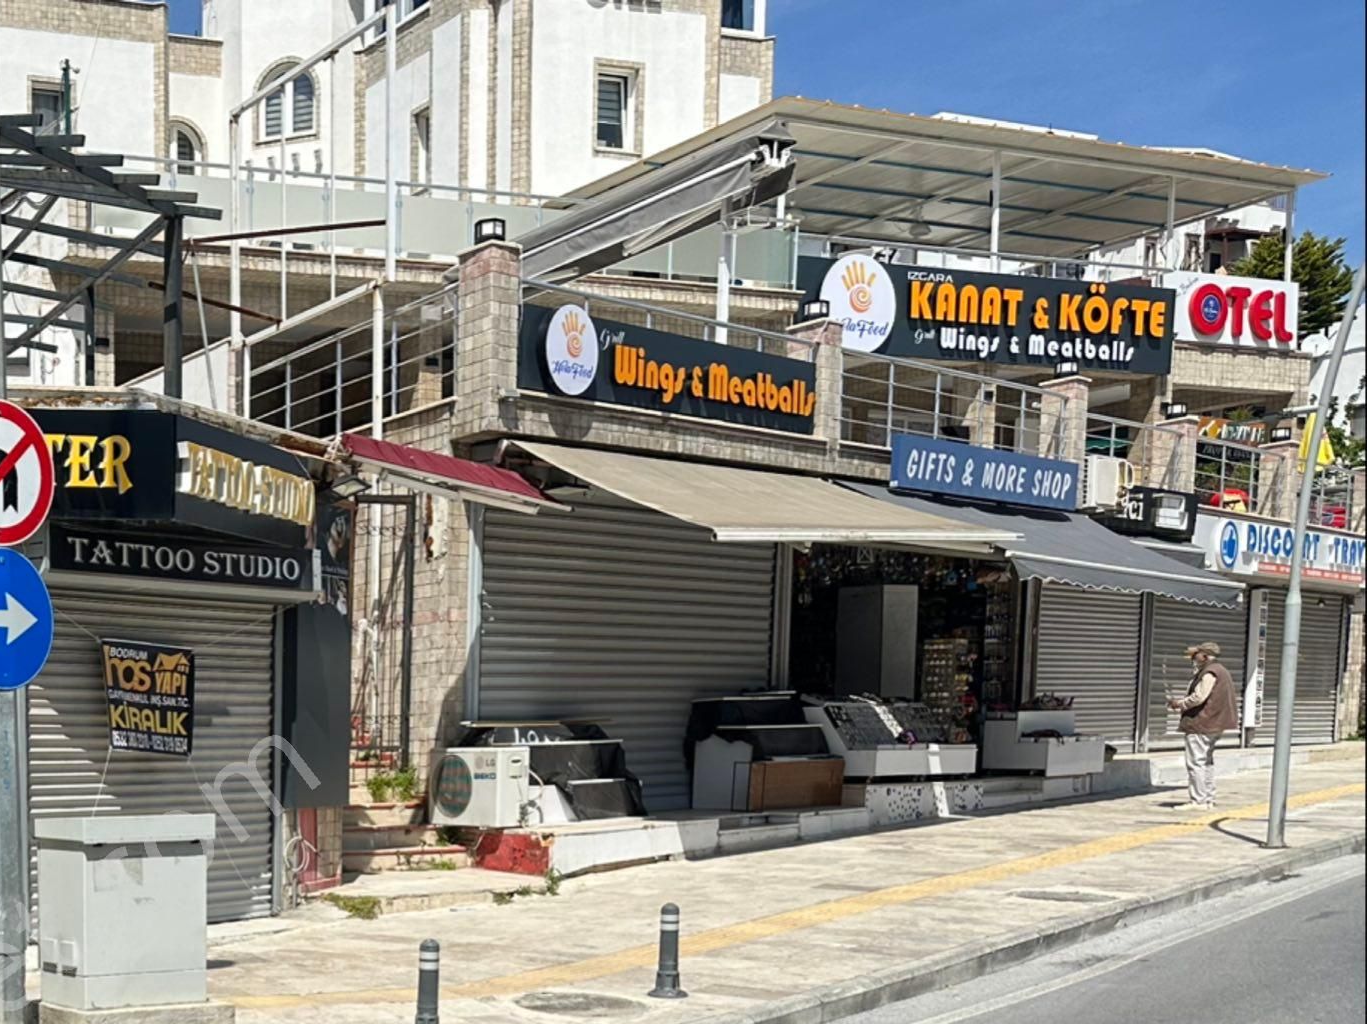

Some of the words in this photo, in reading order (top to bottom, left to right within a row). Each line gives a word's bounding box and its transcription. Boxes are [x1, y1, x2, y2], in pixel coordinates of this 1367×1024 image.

[910, 280, 1024, 327] KANAT
[1034, 297, 1050, 330] &
[1059, 283, 1166, 338] KÖFTE
[1188, 283, 1293, 343] OTEL
[940, 327, 1000, 359] Wings
[1010, 336, 1021, 354] &
[1028, 334, 1134, 362] Meatballs
[614, 344, 686, 404] Wings
[691, 366, 703, 397] &
[708, 362, 817, 418] Meatballs
[906, 448, 956, 483] GIFTS
[961, 458, 974, 487] &
[981, 461, 1027, 494] MORE
[1033, 469, 1072, 501] SHOP
[67, 536, 195, 572] TATTOO
[203, 551, 300, 581] STUDIO
[1247, 524, 1320, 561] DISCONT
[111, 647, 148, 660] BODRUM
[155, 672, 188, 696] YAPI
[110, 701, 189, 735] KİRALIK
